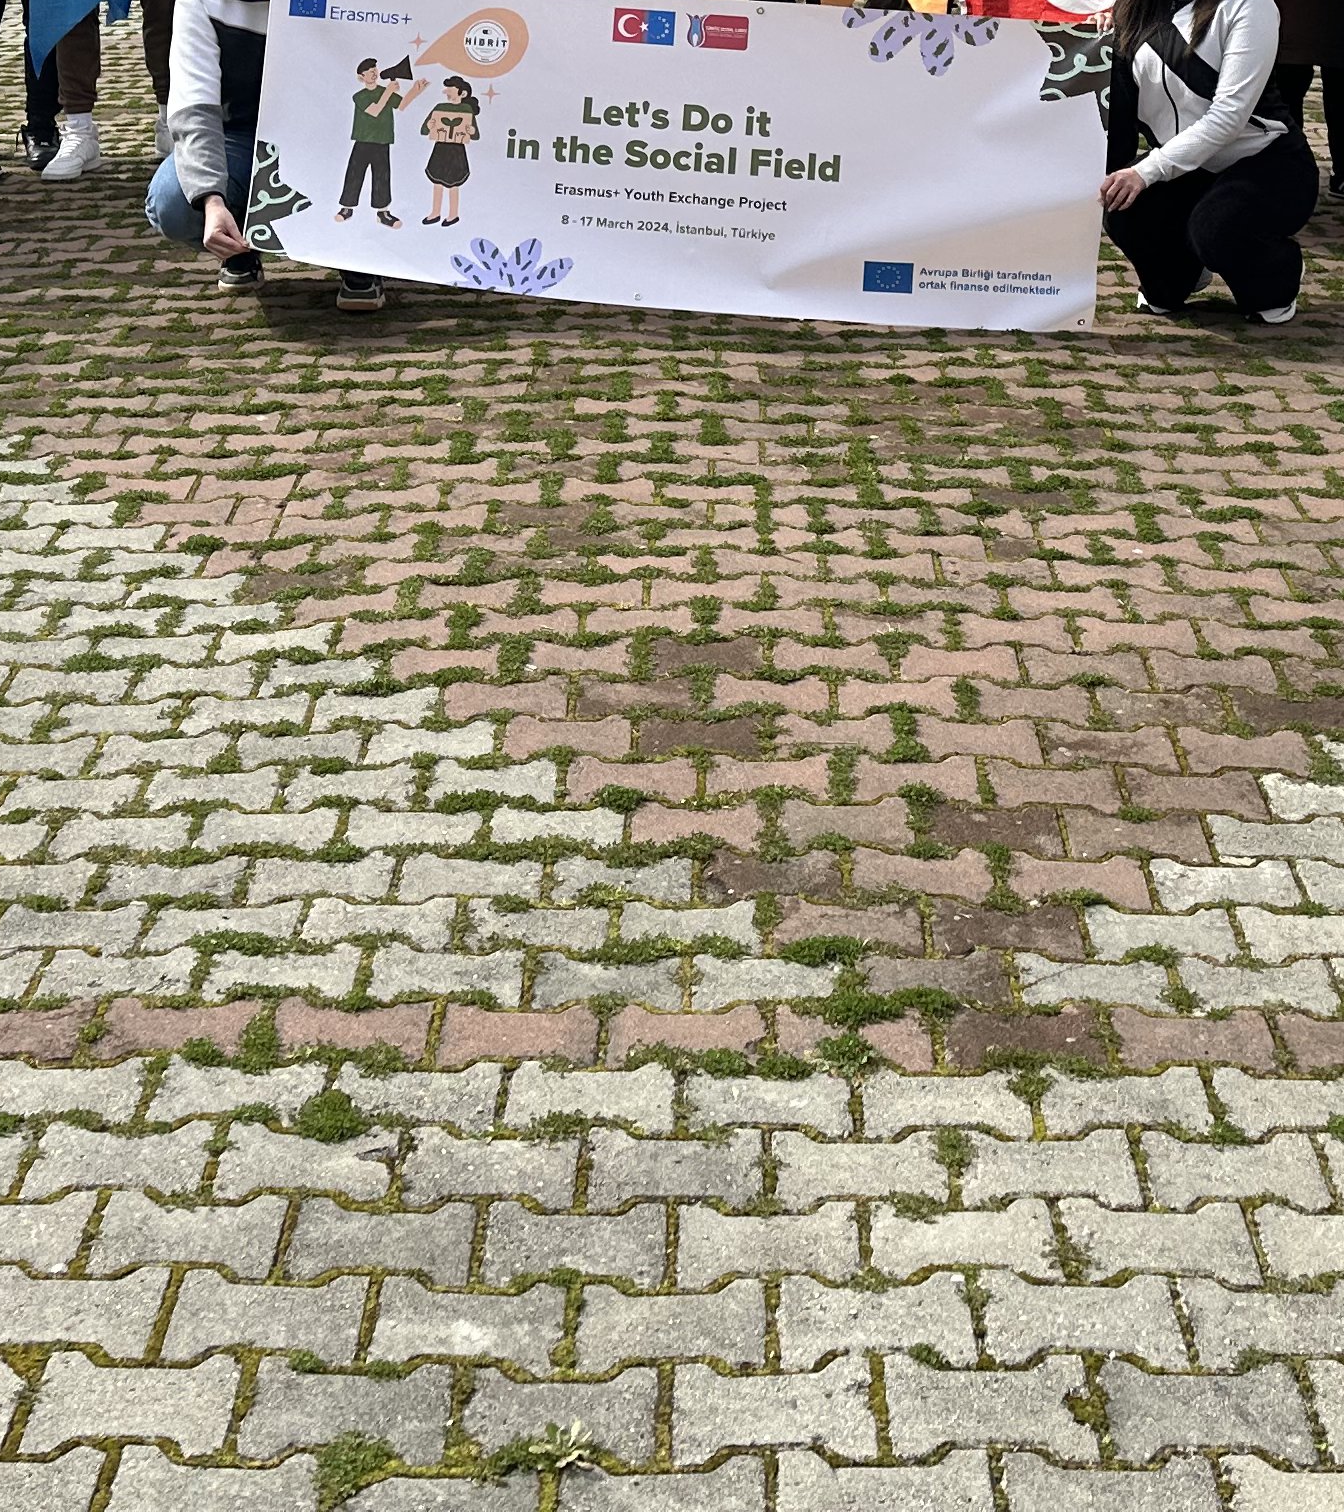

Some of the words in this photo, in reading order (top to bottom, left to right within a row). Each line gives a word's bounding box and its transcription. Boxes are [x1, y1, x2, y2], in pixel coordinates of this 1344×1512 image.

[330, 5, 413, 25] Erasmus+
[582, 96, 670, 130] Let's
[682, 103, 734, 134] Do
[745, 106, 771, 137] it
[506, 128, 540, 160] in
[552, 136, 613, 165] the
[624, 139, 738, 175] Social
[750, 147, 841, 182] Field
[554, 183, 620, 199] Erasmus+
[624, 188, 665, 202] Youth
[668, 191, 735, 209] Exchange
[738, 197, 787, 212] Project
[561, 215, 569, 225] 8
[580, 216, 593, 227] 17
[596, 217, 634, 230] March
[637, 220, 673, 234] 2024,
[731, 227, 776, 241] Türkiye
[919, 267, 958, 278] Avrupa
[961, 268, 994, 281] Birliği
[918, 280, 947, 290] ortak
[950, 281, 989, 292] finanse
[992, 284, 1061, 296] edilmektedir
